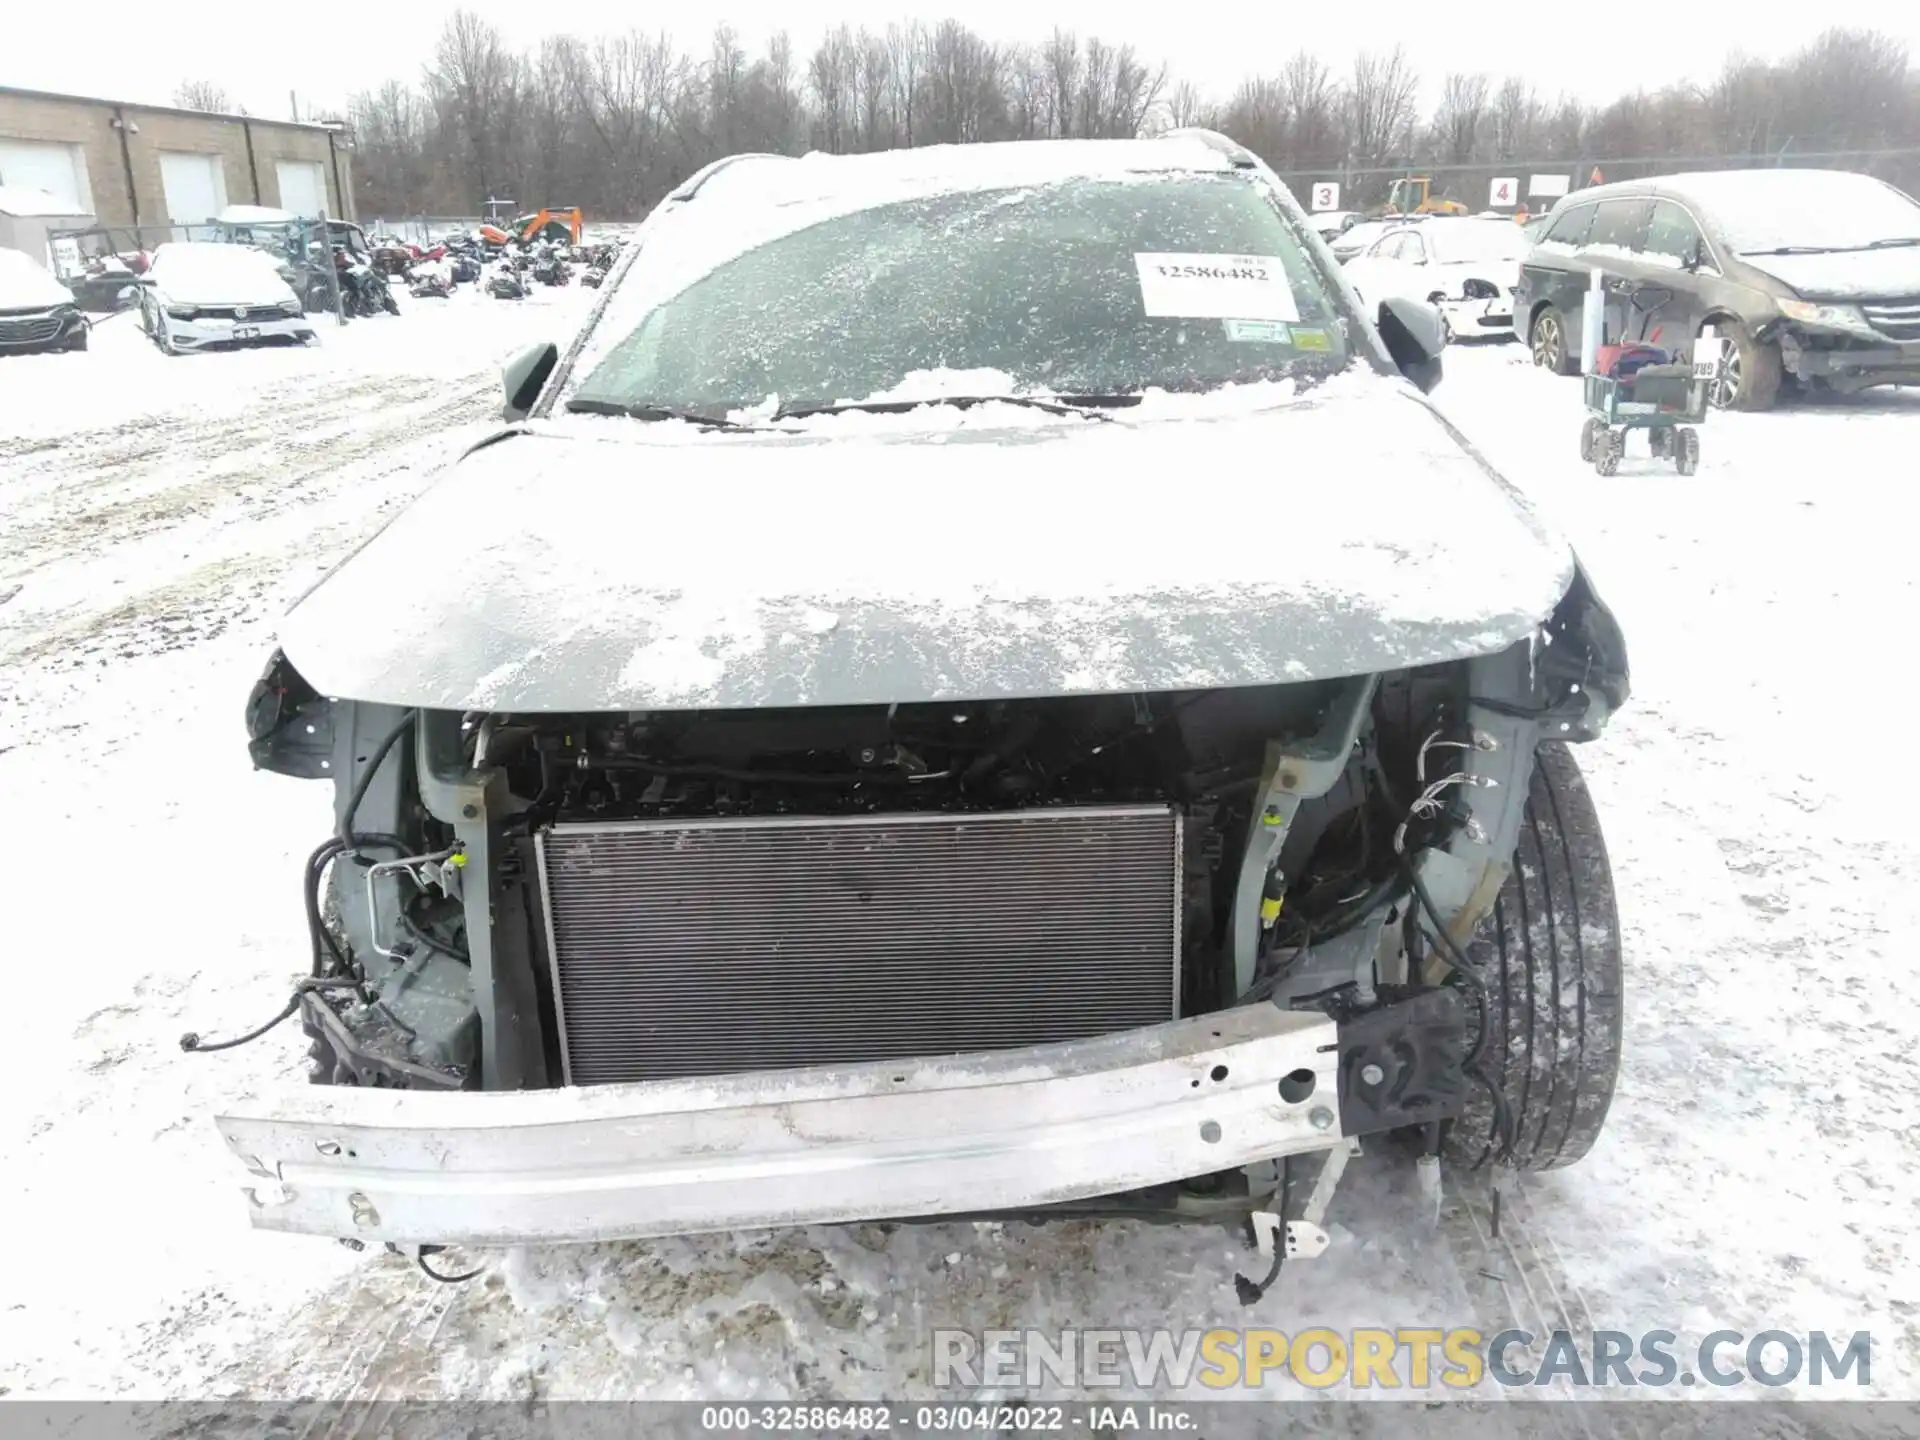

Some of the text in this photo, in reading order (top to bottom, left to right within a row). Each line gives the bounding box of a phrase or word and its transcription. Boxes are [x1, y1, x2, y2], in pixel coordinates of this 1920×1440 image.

[1319, 188, 1332, 206] 3
[1496, 183, 1509, 201] 4
[1157, 264, 1269, 281] 32586482
